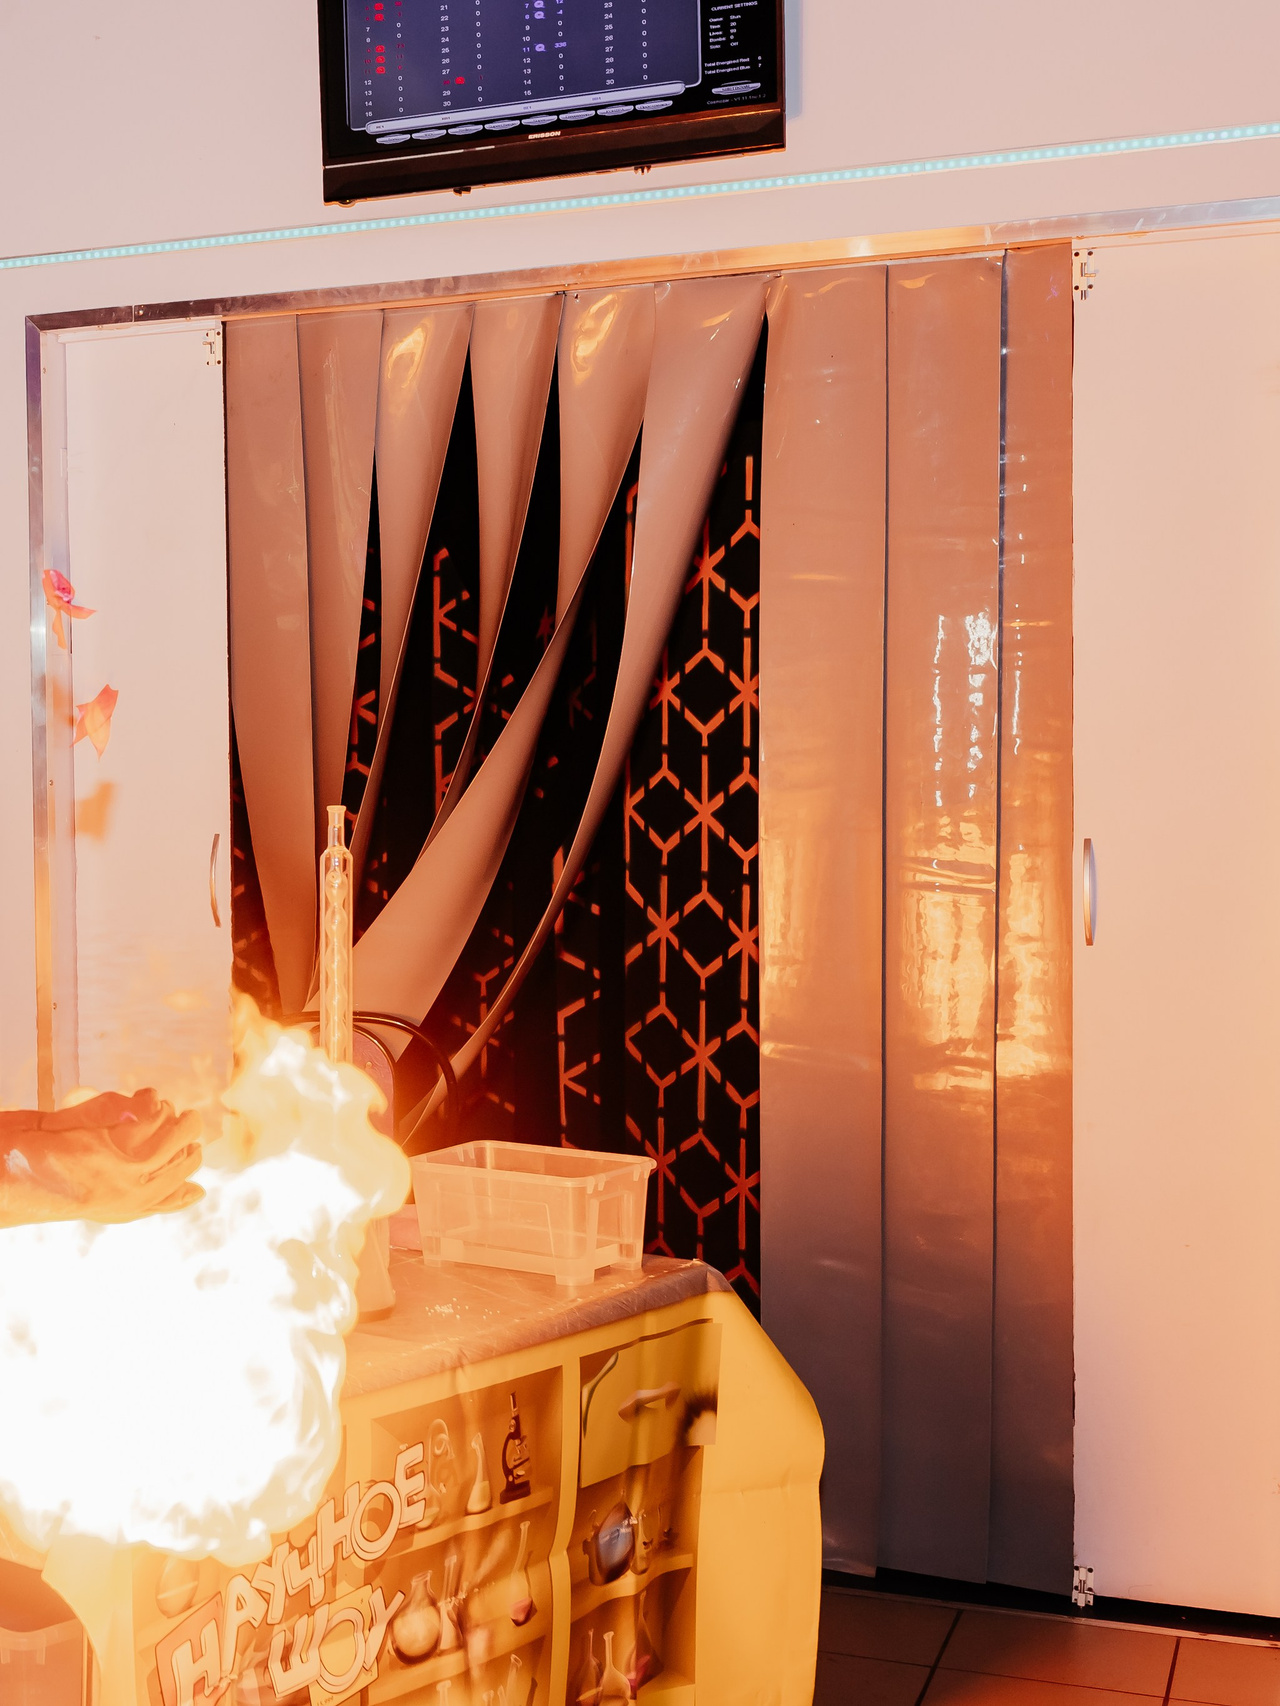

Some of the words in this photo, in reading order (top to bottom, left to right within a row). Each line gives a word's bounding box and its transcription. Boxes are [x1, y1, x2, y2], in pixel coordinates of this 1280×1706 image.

[528, 131, 561, 140] ERISSON
[171, 1442, 426, 1706] НАУЧНОЕ
[270, 1587, 405, 1699] ШОУ
